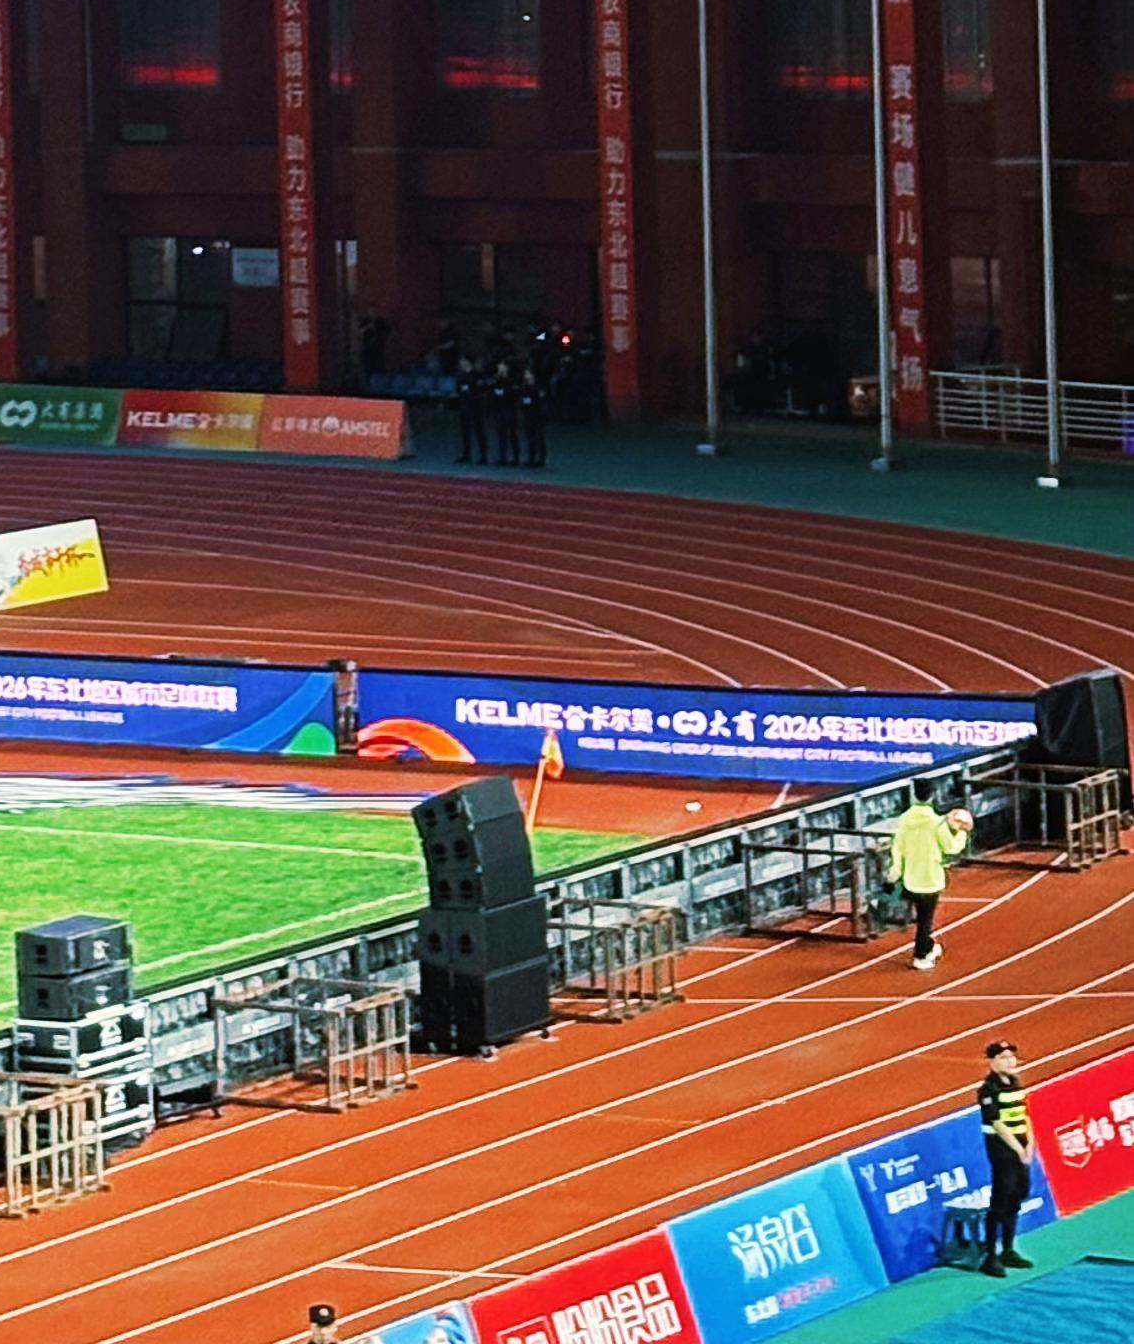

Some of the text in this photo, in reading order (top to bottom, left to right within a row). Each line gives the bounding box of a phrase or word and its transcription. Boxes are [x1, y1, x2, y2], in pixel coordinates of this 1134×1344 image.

[286, 134, 311, 346] 助力东北超赛事
[605, 137, 631, 354] 助力东北超赛事
[889, 63, 925, 392] 赛场健儿意气扬
[126, 411, 195, 429] KELME
[456, 698, 564, 730] KELME
